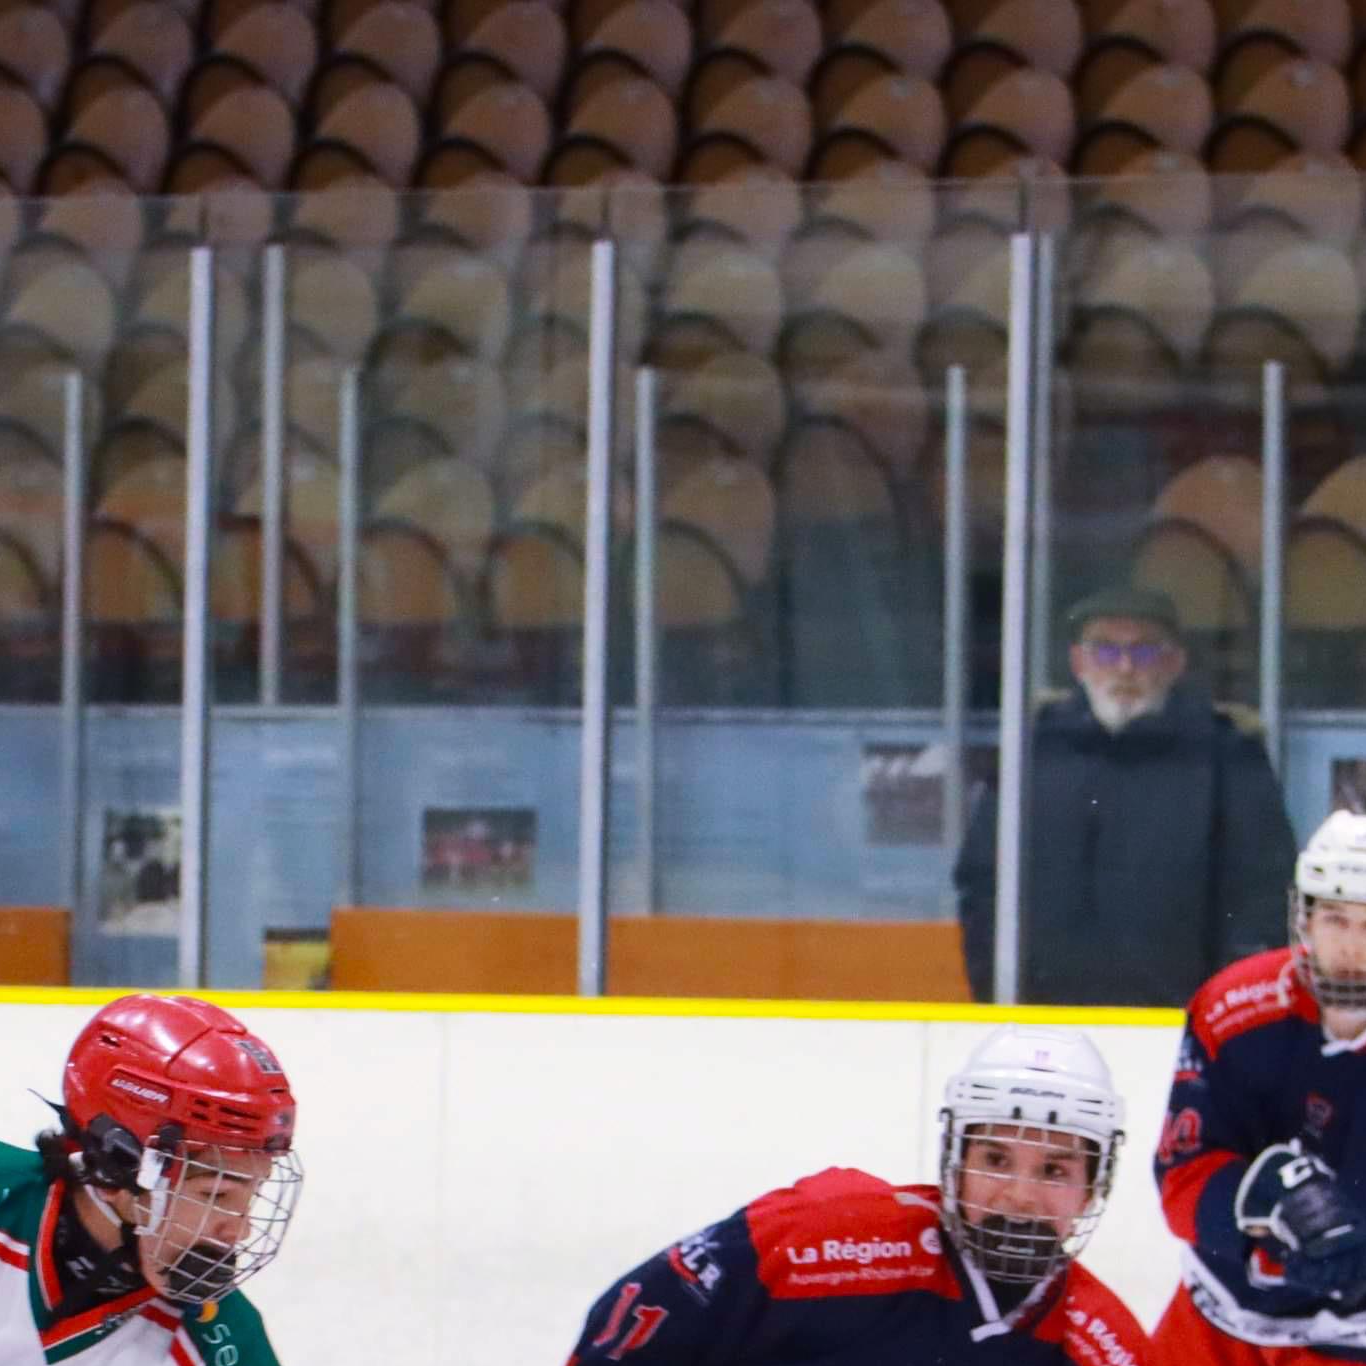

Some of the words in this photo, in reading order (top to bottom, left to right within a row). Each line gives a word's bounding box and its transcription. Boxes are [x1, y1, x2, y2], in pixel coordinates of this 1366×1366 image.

[786, 1246, 818, 1265] La
[822, 1235, 913, 1265] Région
[591, 1282, 670, 1361] 11
